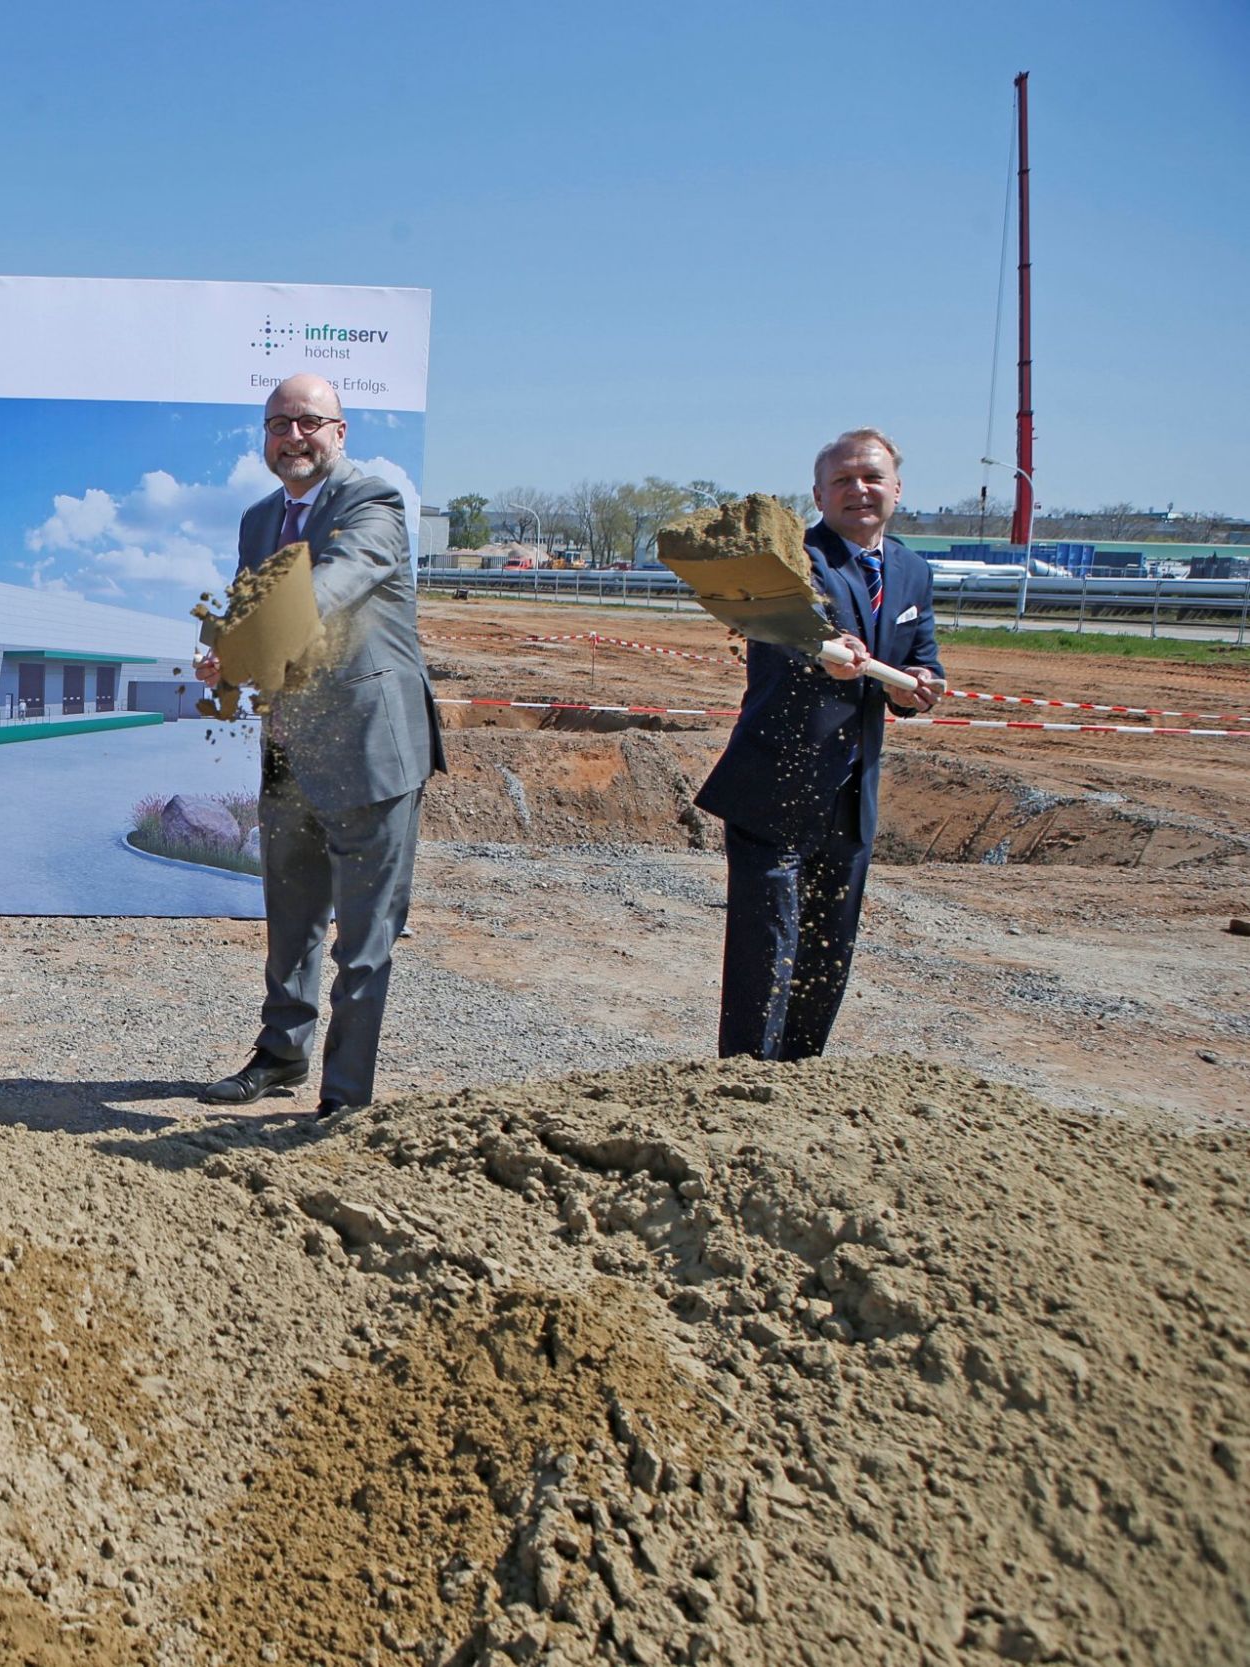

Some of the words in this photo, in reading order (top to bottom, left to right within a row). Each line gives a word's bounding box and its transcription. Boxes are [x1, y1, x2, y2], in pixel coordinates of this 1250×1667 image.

[304, 323, 388, 343] infraserv
[304, 346, 351, 360] höchst
[344, 377, 390, 394] Erfolgs.
